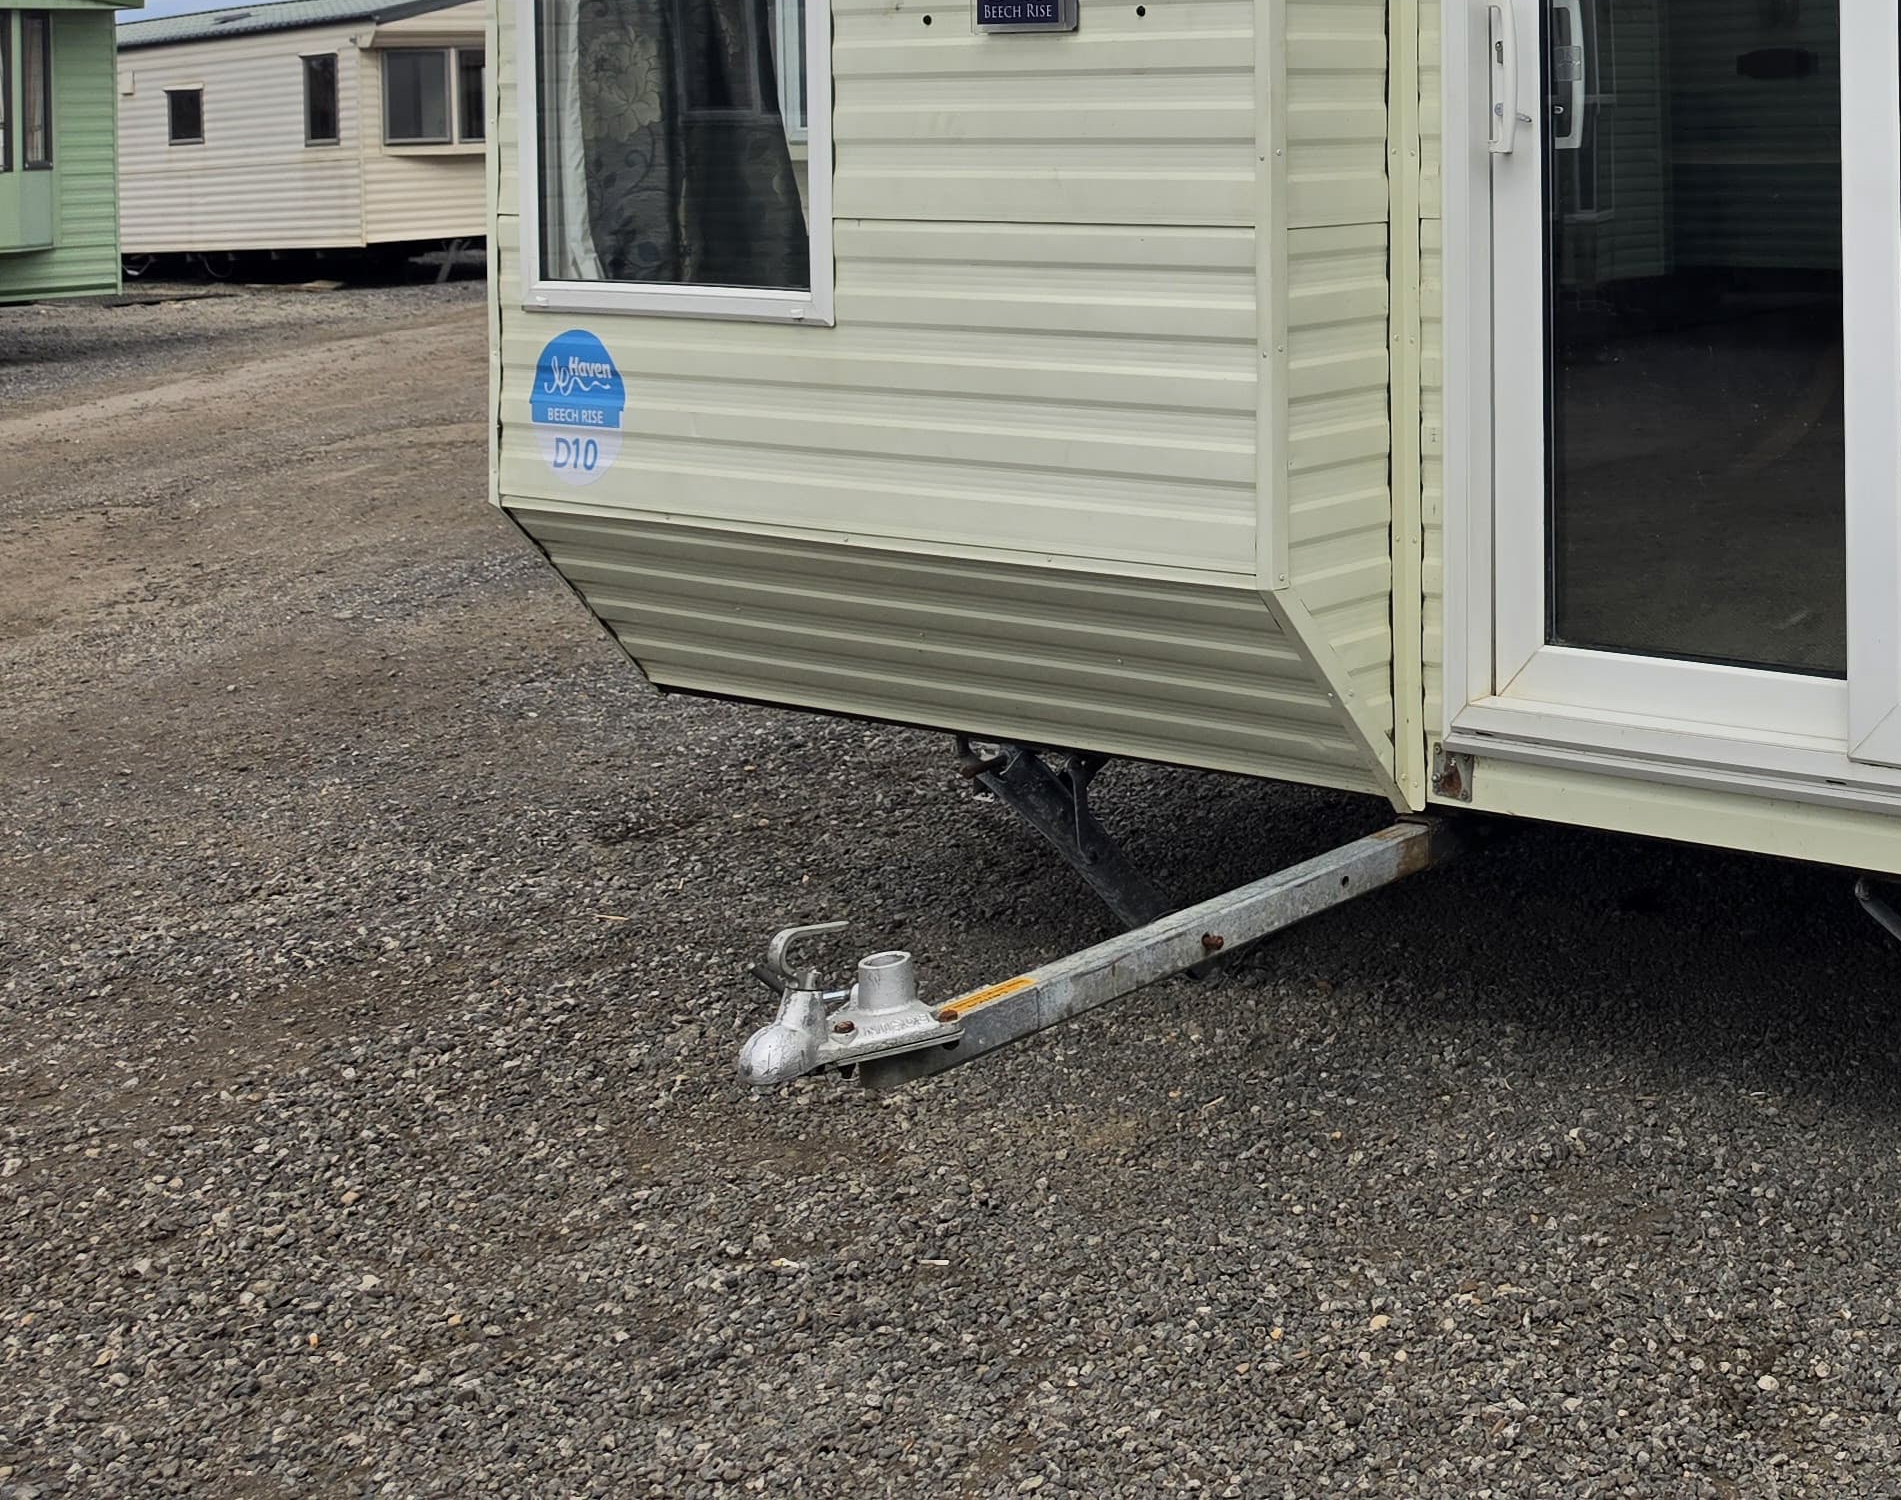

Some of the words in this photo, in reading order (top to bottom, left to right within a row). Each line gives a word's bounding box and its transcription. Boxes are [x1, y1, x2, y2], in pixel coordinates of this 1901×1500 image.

[984, 3, 1021, 19] BEECH
[1027, 3, 1052, 18] RISE
[568, 356, 612, 379] Haven
[547, 407, 579, 423] BEECH
[581, 409, 604, 424] RISE
[553, 437, 599, 471] D10
